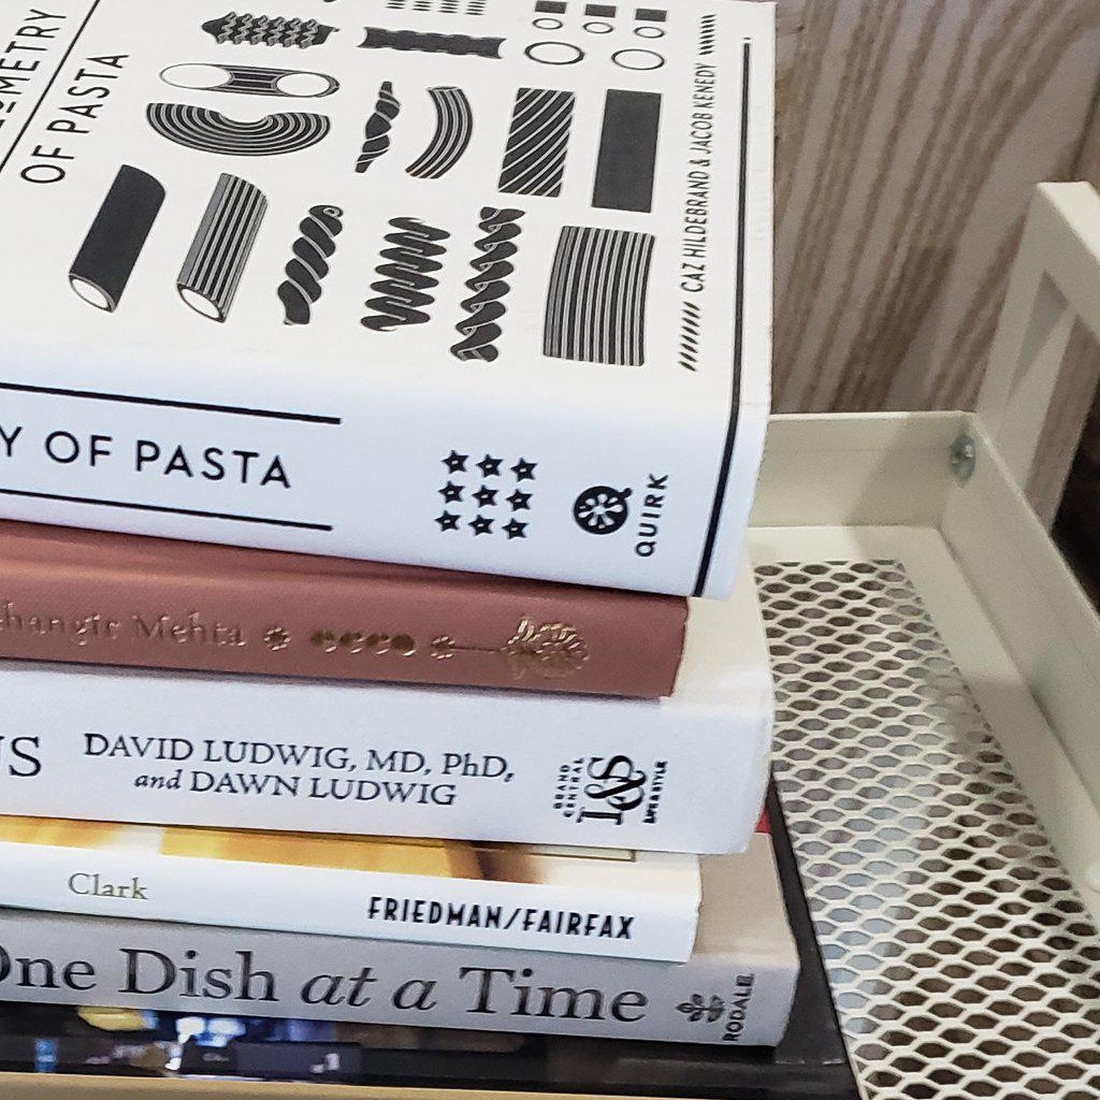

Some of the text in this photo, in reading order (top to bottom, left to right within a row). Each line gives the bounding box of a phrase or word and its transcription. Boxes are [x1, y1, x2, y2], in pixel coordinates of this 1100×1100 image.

[20, 54, 129, 184] OF PASTA
[681, 63, 717, 293] CAZ HILDEBRAND & JACOB KENEDY
[45, 431, 112, 467] OF
[135, 440, 291, 489] PASTA
[635, 473, 669, 557] QUIRK
[132, 611, 247, 647] Mehta
[84, 733, 515, 782] DAVID LUDWIG, MD, PhD,
[134, 769, 457, 805] and DAWN LUDWIG
[69, 872, 149, 902] Clark
[368, 896, 635, 940] FRIEDMAN/FAIRFAX
[119, 946, 278, 1003] Dish
[301, 966, 378, 1009] at
[392, 976, 436, 1012] a
[459, 965, 648, 1025] Time
[722, 973, 754, 1041] RODALE
